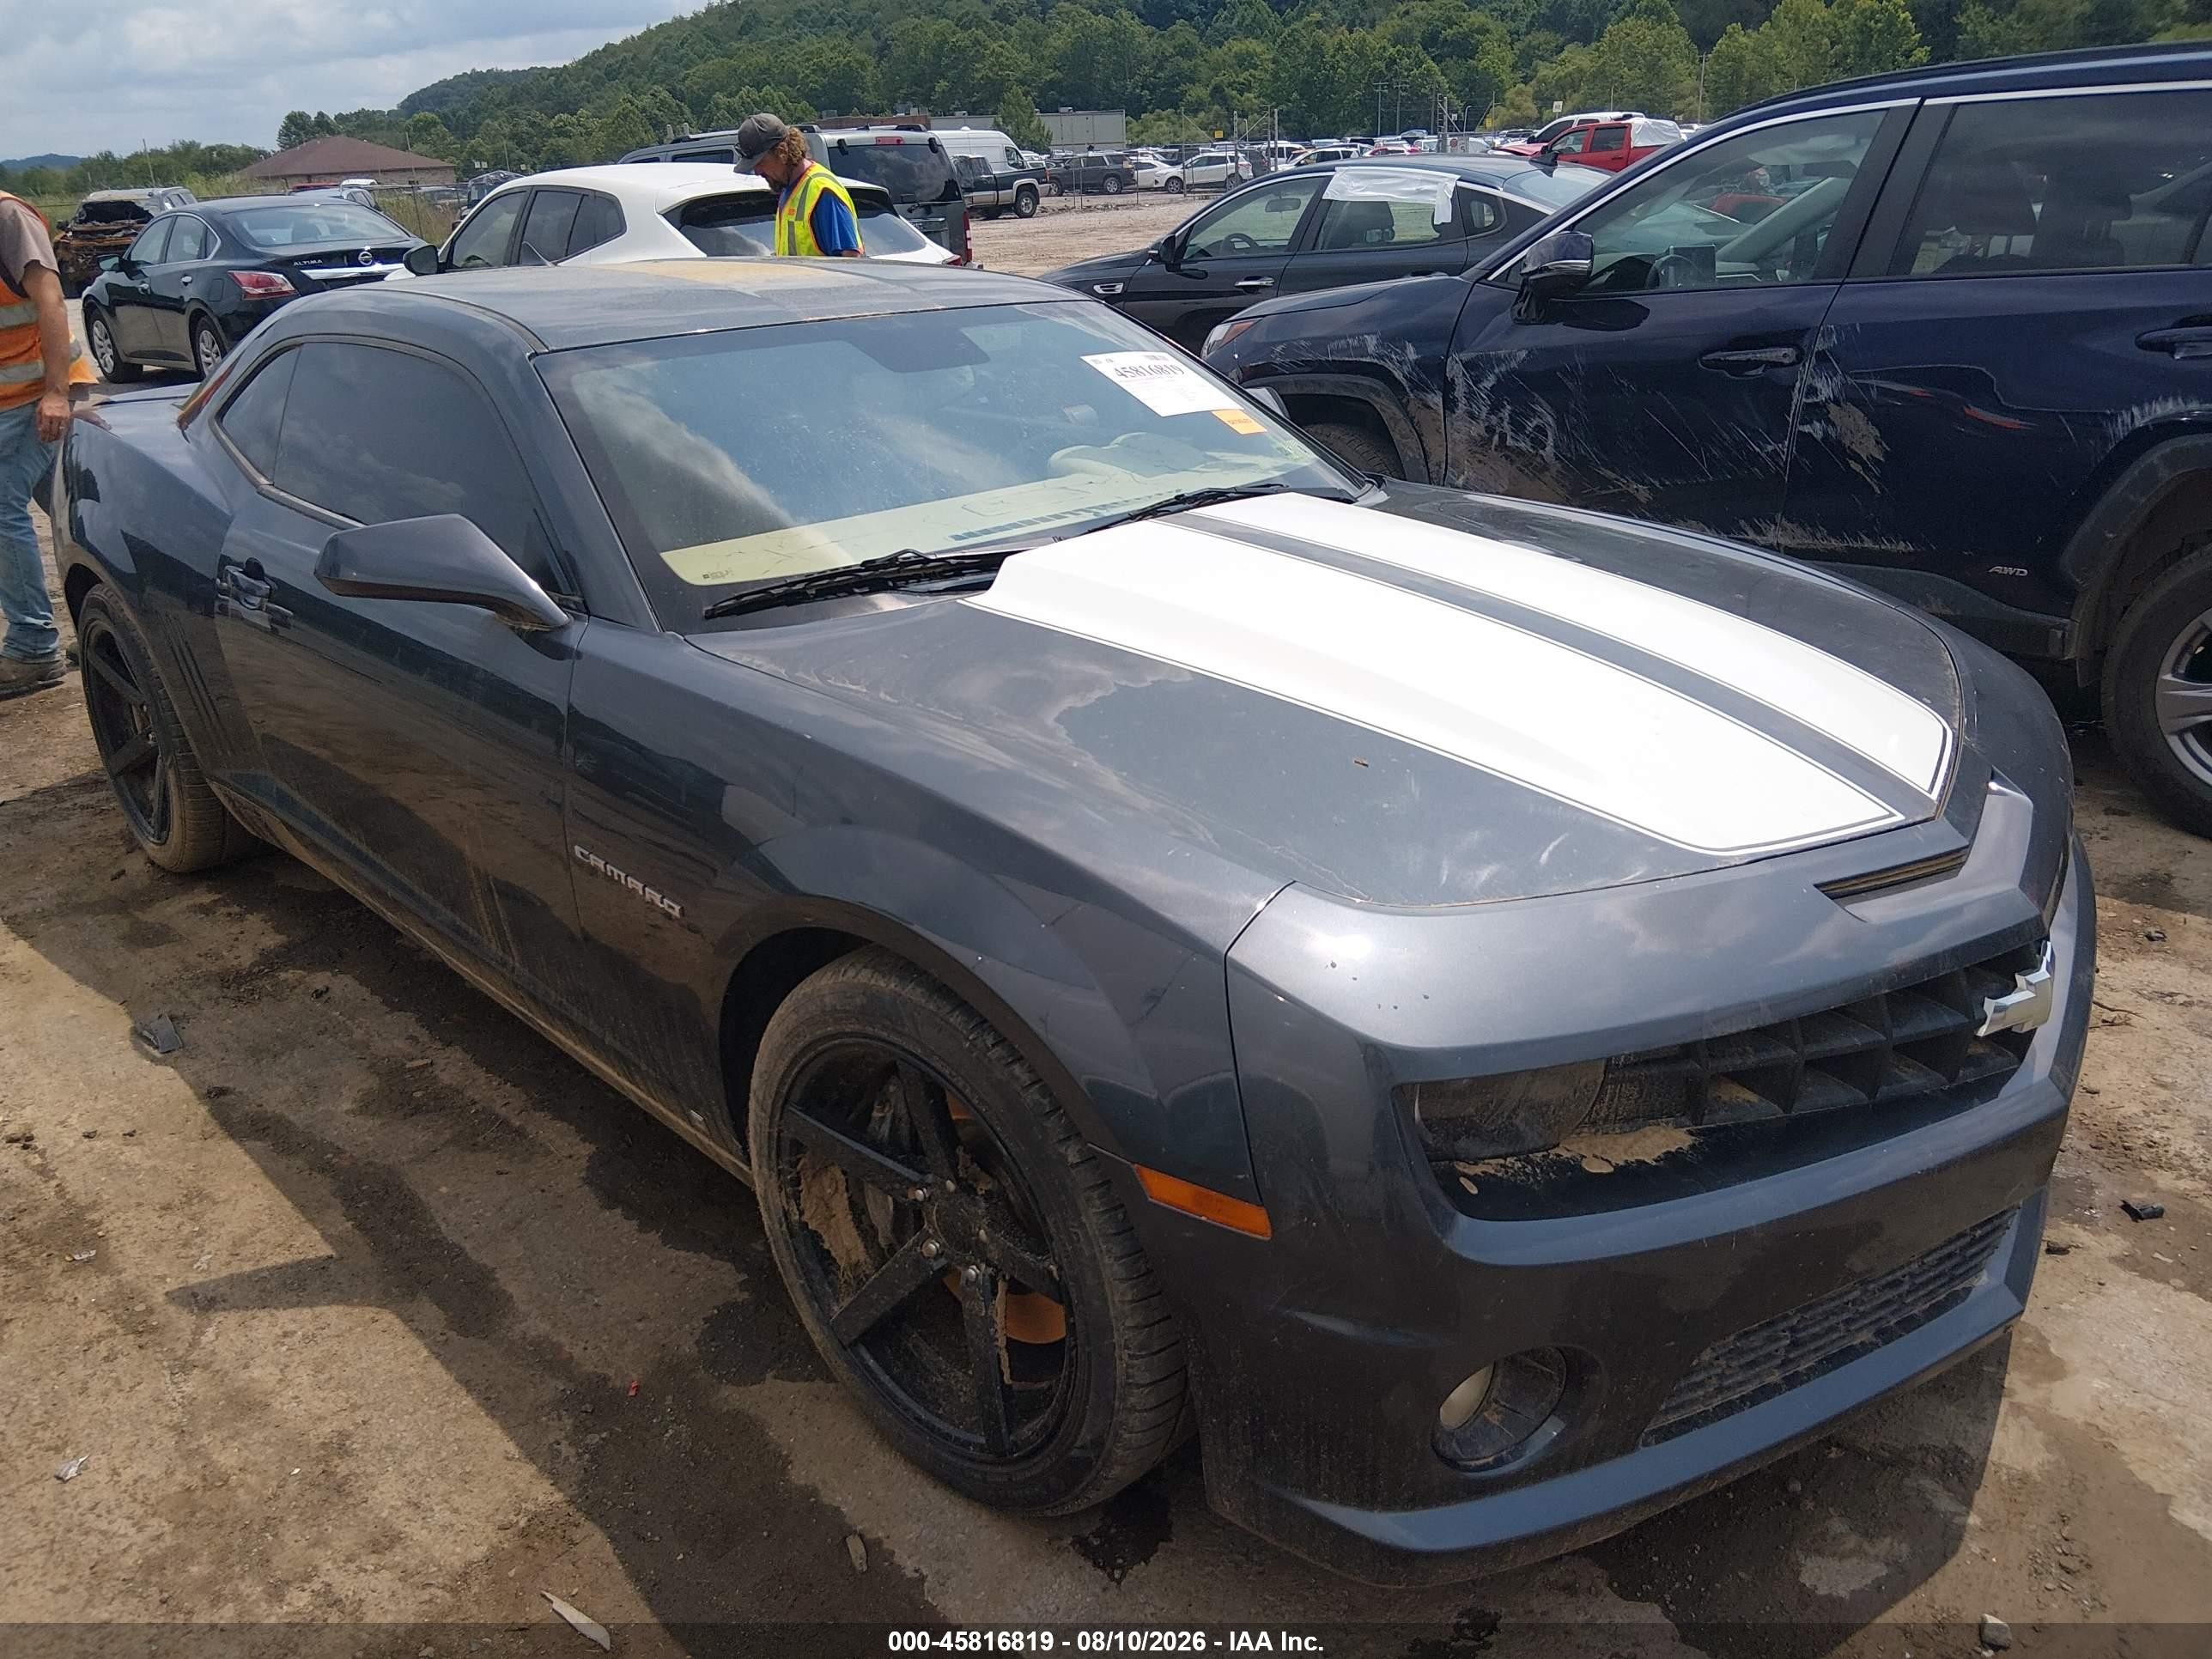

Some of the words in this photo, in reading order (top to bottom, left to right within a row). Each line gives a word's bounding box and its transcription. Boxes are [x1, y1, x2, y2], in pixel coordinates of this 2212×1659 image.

[1114, 364, 1185, 379] 45816819
[1988, 566, 2028, 576] AWD
[574, 845, 683, 919] CAMARO
